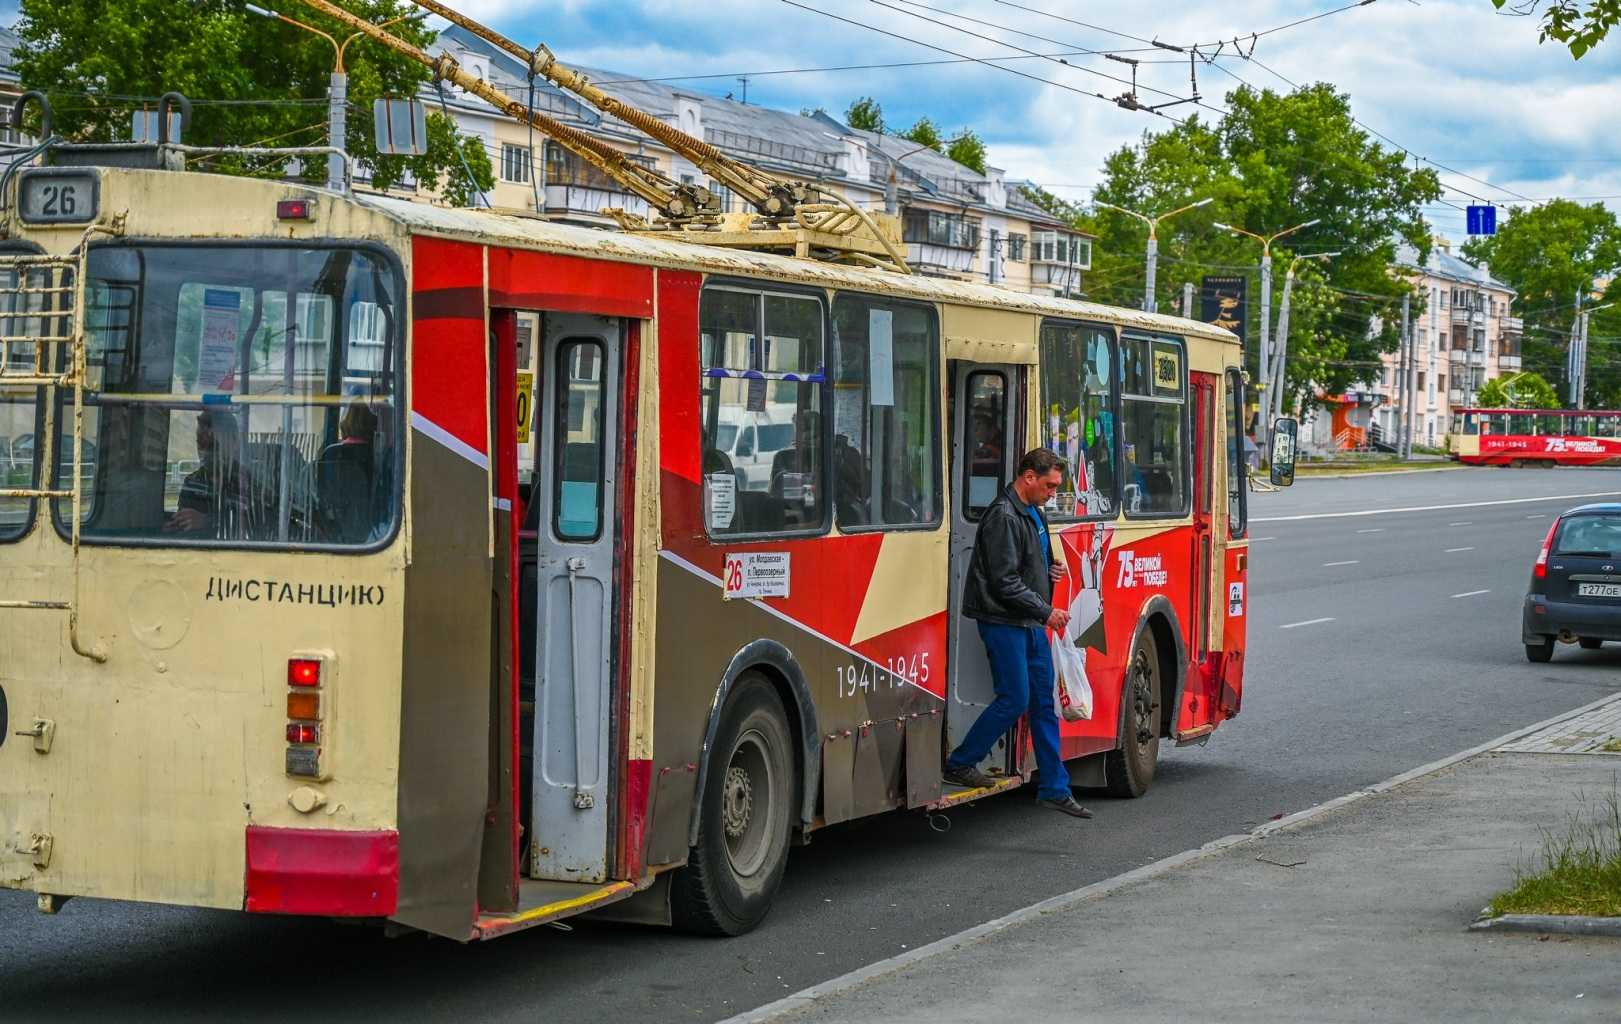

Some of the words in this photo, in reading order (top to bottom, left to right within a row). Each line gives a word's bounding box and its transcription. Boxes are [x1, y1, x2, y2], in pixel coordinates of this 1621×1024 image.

[43, 186, 75, 215] 26
[1488, 440, 1527, 448] 1941-1945
[1545, 438, 1566, 452] 75
[1565, 440, 1598, 448] ВЕЛИКОЙ
[727, 560, 742, 591] 26
[1117, 551, 1134, 588] 75
[1134, 553, 1162, 571] ВЕЛИКОЙ
[206, 577, 384, 607] ДИСТАНЦИЮ
[836, 652, 929, 698] 1941-1945
